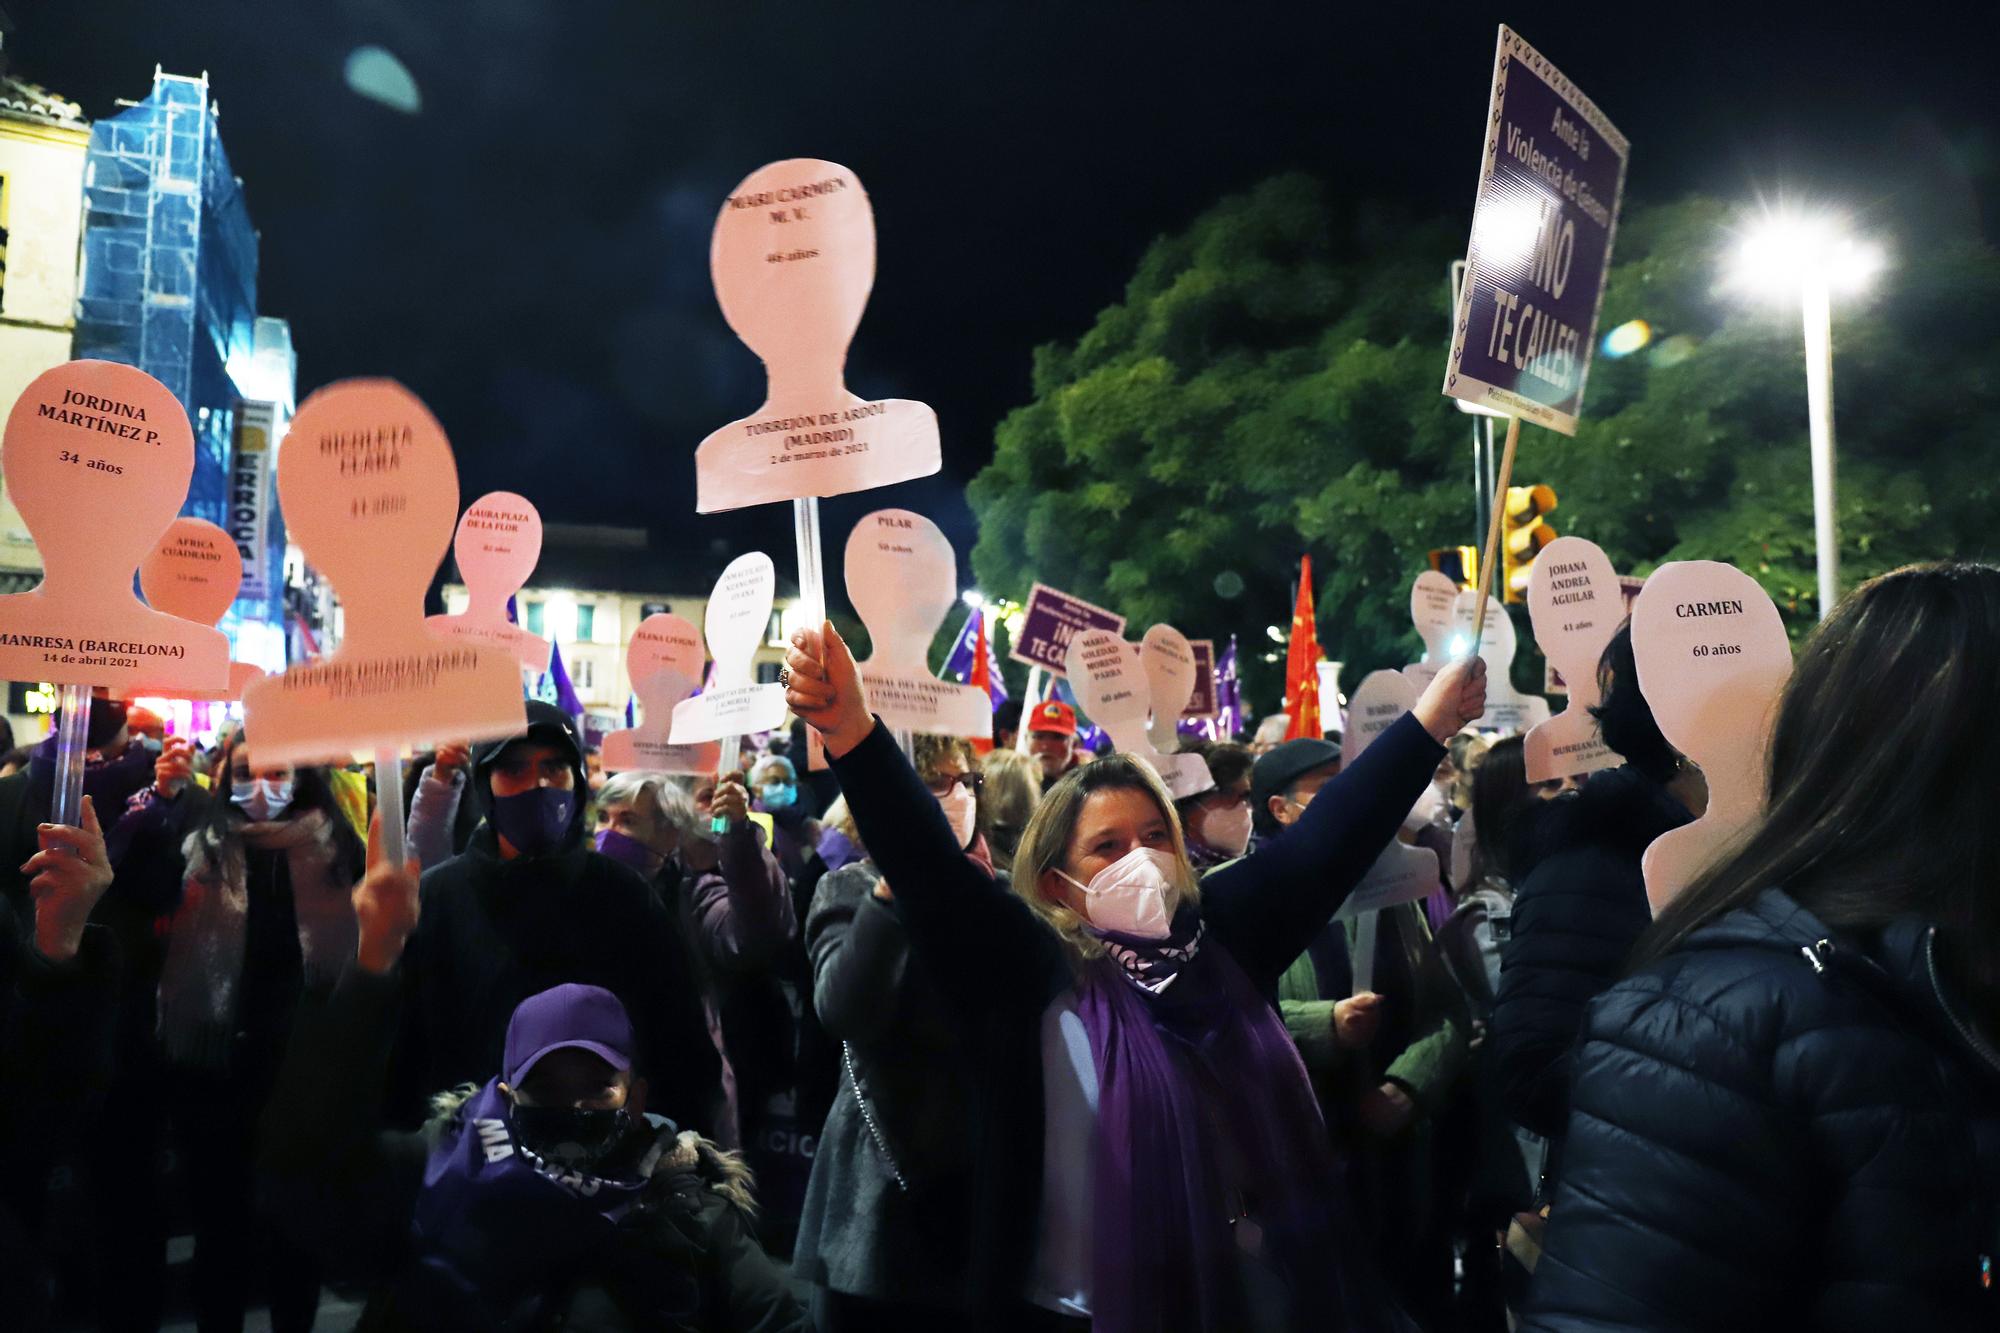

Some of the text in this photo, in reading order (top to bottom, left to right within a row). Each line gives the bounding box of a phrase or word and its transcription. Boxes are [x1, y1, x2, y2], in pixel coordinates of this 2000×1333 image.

[1551, 106, 1590, 161] Ante la
[1507, 121, 1563, 188] Violencia
[1563, 169, 1579, 201] de
[775, 178, 846, 202] CARMEN
[1488, 287, 1519, 363] TE
[63, 389, 147, 422] JORDINA
[38, 403, 161, 446] MARTÍNEZ P.
[819, 412, 838, 426] DE
[783, 428, 854, 451] (MADRID)
[59, 450, 124, 475] 34 años
[770, 455, 777, 465] 2
[779, 454, 792, 463] de
[793, 450, 827, 461] marzo
[829, 447, 842, 457] de
[469, 508, 529, 522] LAURA PLAZA
[877, 515, 912, 529] PILAR
[467, 519, 518, 532] DE LA FLOR
[162, 547, 221, 561] CUADRADO
[1549, 561, 1588, 578] JOHANA
[1551, 576, 1591, 590] ANDREA
[1552, 590, 1595, 606] AGUILAR
[1676, 600, 1743, 618] CARMEN
[0, 633, 185, 660] MANRESA (BARCELONA)
[1031, 636, 1048, 658] TE
[1081, 645, 1119, 659] SOLEDAD
[1693, 643, 1742, 657] 60 años
[43, 653, 138, 668] 14 de abril 2021
[1086, 655, 1122, 670] MORENO
[1094, 668, 1122, 681] PARRA
[1553, 741, 1598, 756] BURRIANA
